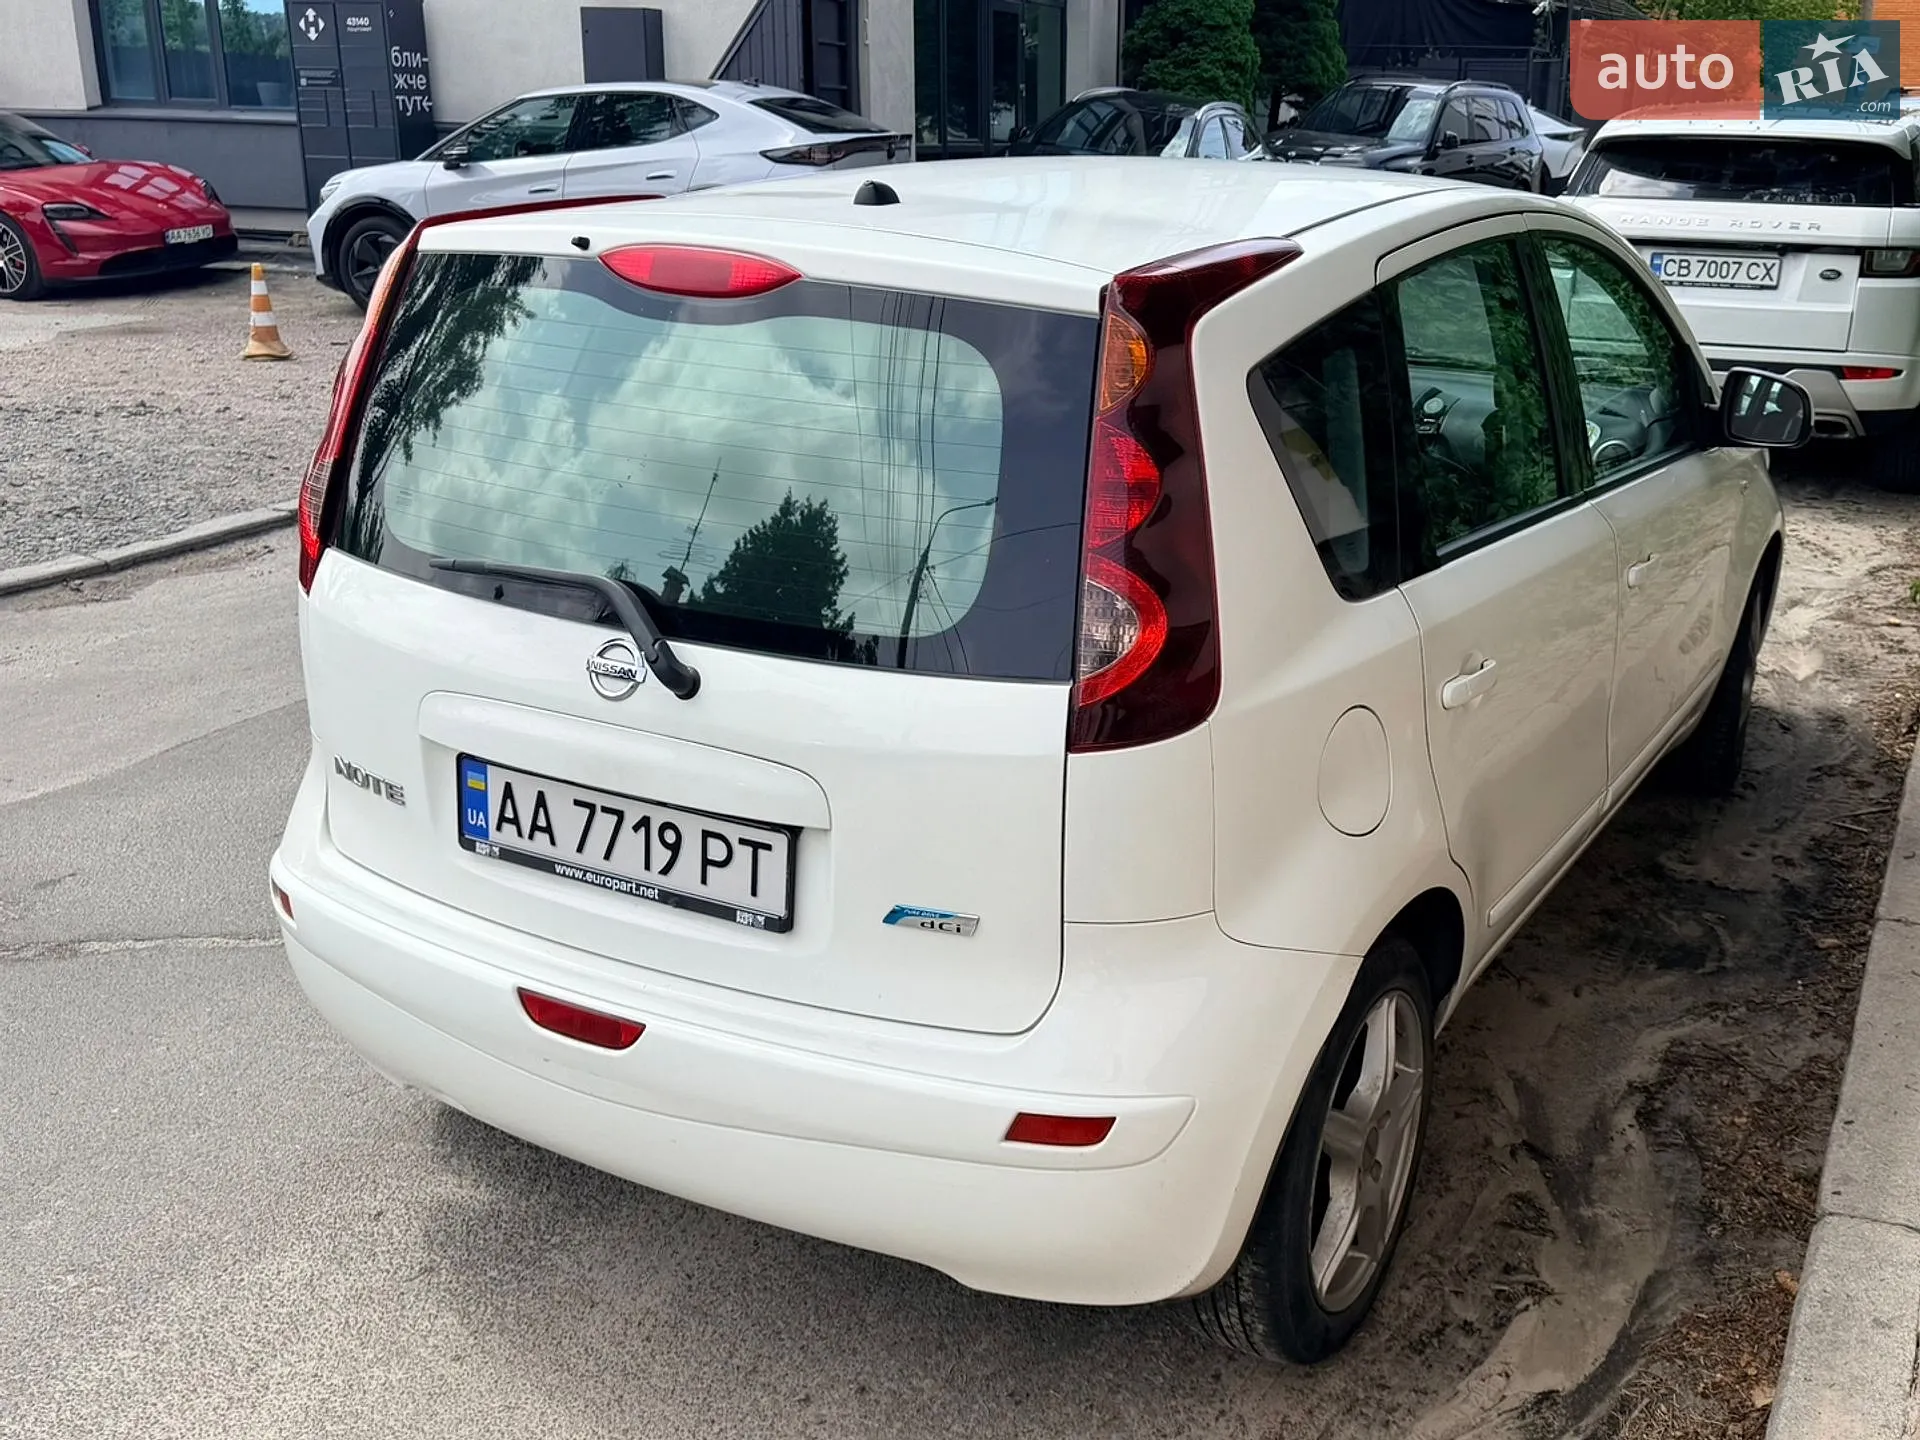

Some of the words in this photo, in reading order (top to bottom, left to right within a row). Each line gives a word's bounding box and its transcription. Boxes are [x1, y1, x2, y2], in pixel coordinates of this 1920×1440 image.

[391, 46, 429, 68] бли-
[393, 73, 427, 90] жче
[396, 95, 424, 117] тут
[1618, 214, 1710, 227] RANGE
[1729, 219, 1822, 231] ROVER
[1663, 258, 1691, 278] CB
[1695, 260, 1742, 280] 7007
[1746, 262, 1776, 282] CX
[591, 660, 637, 679] NISSAN
[334, 754, 406, 807] NOTE
[467, 808, 487, 829] UA
[495, 780, 557, 848] AA
[573, 798, 683, 876] 7719
[700, 828, 773, 898] PT
[554, 863, 660, 900] www.europart.net
